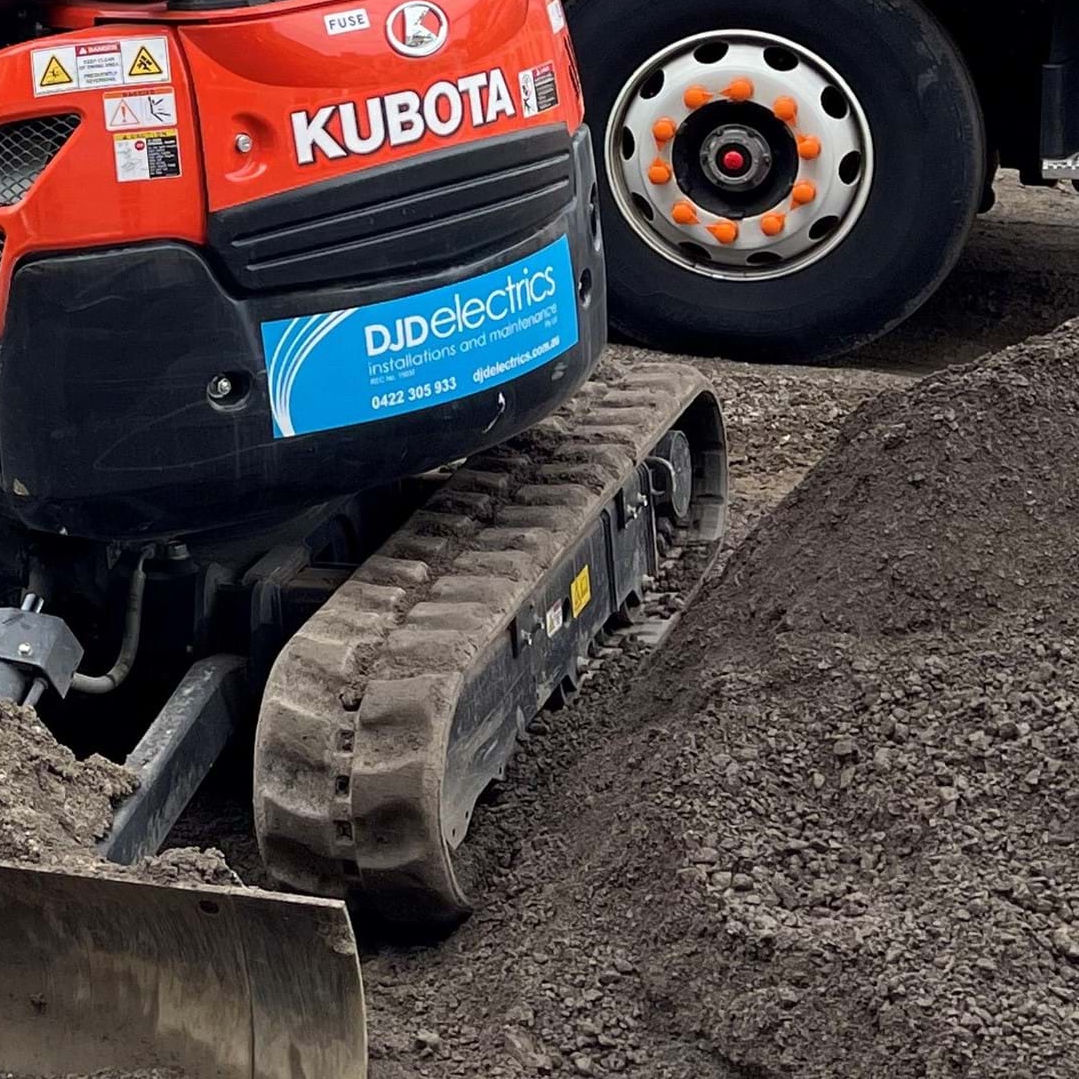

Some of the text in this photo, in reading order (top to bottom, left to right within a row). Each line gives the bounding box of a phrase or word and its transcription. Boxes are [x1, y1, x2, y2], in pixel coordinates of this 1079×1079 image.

[328, 13, 366, 30] FUSE
[290, 68, 516, 165] KUBOTA
[364, 266, 556, 356] DJDelectrics
[368, 303, 558, 376] installations and maintenance
[371, 334, 560, 410] 0422 305 933 djdelectrics.com.au
